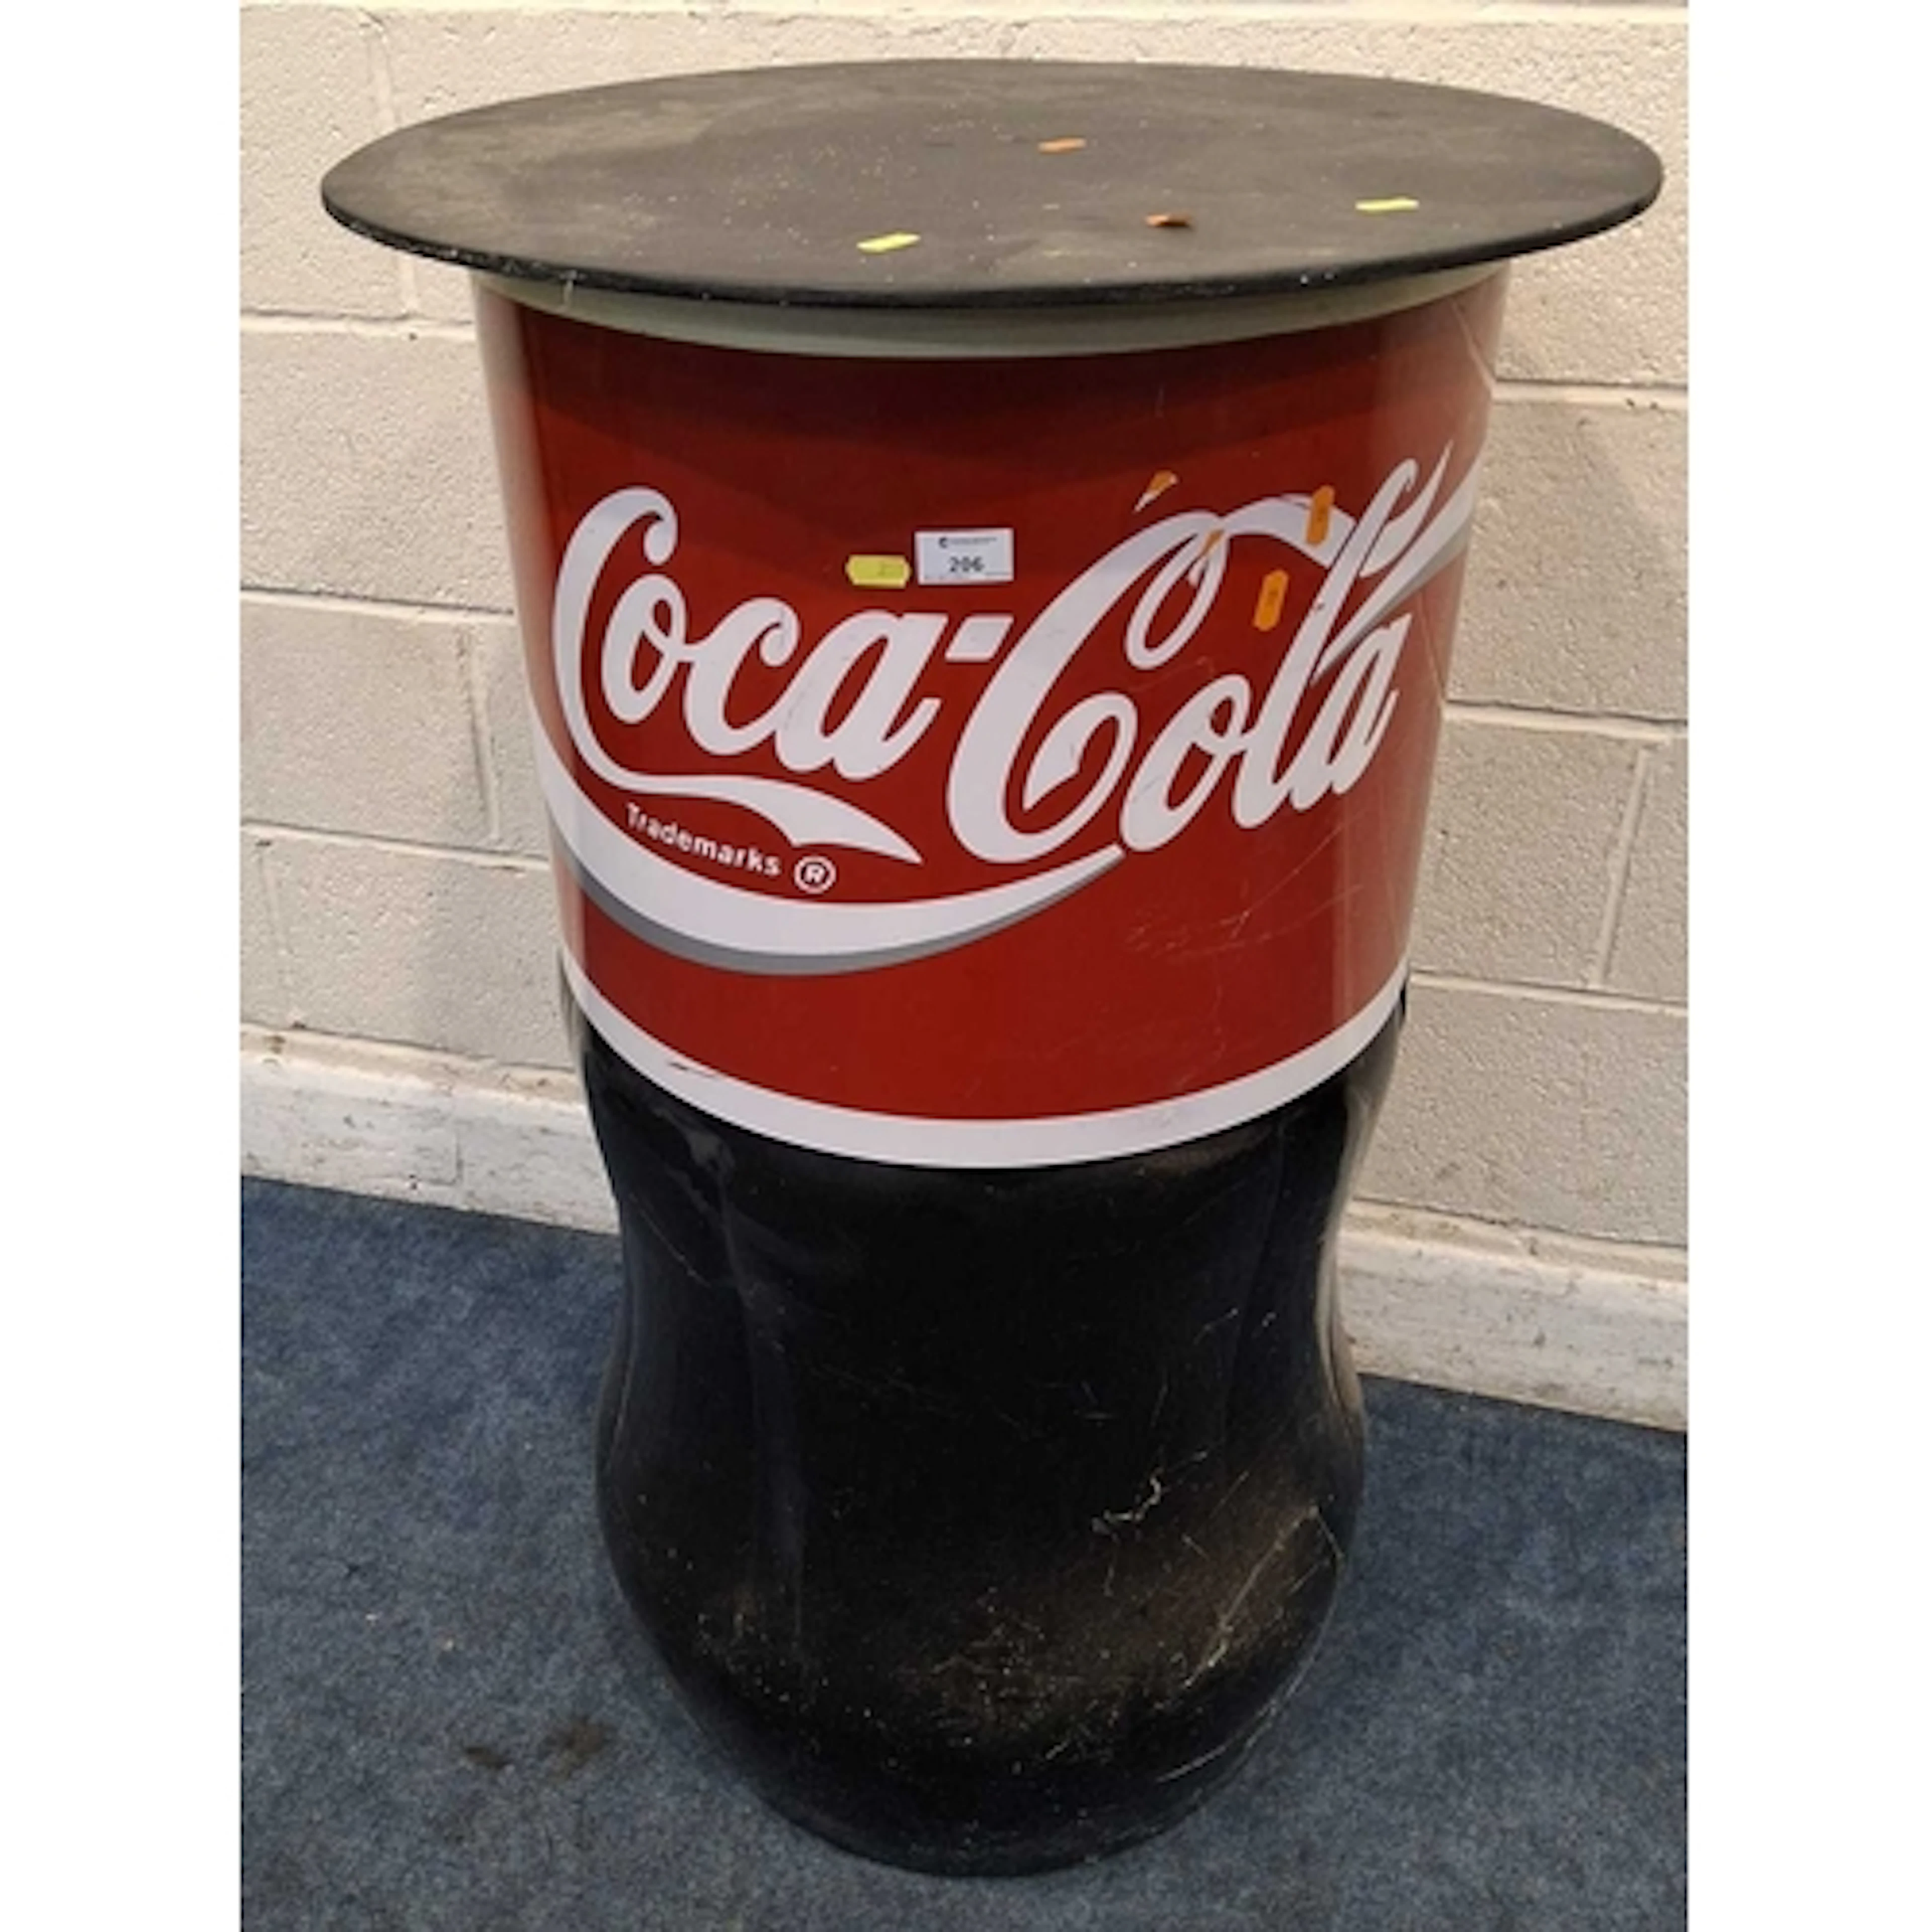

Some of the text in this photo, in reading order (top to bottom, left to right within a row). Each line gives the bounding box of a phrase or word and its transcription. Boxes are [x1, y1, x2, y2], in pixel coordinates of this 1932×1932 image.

[948, 555, 984, 574] 206
[553, 458, 1418, 863] Coca-Cola
[627, 802, 782, 876] Trademarks
